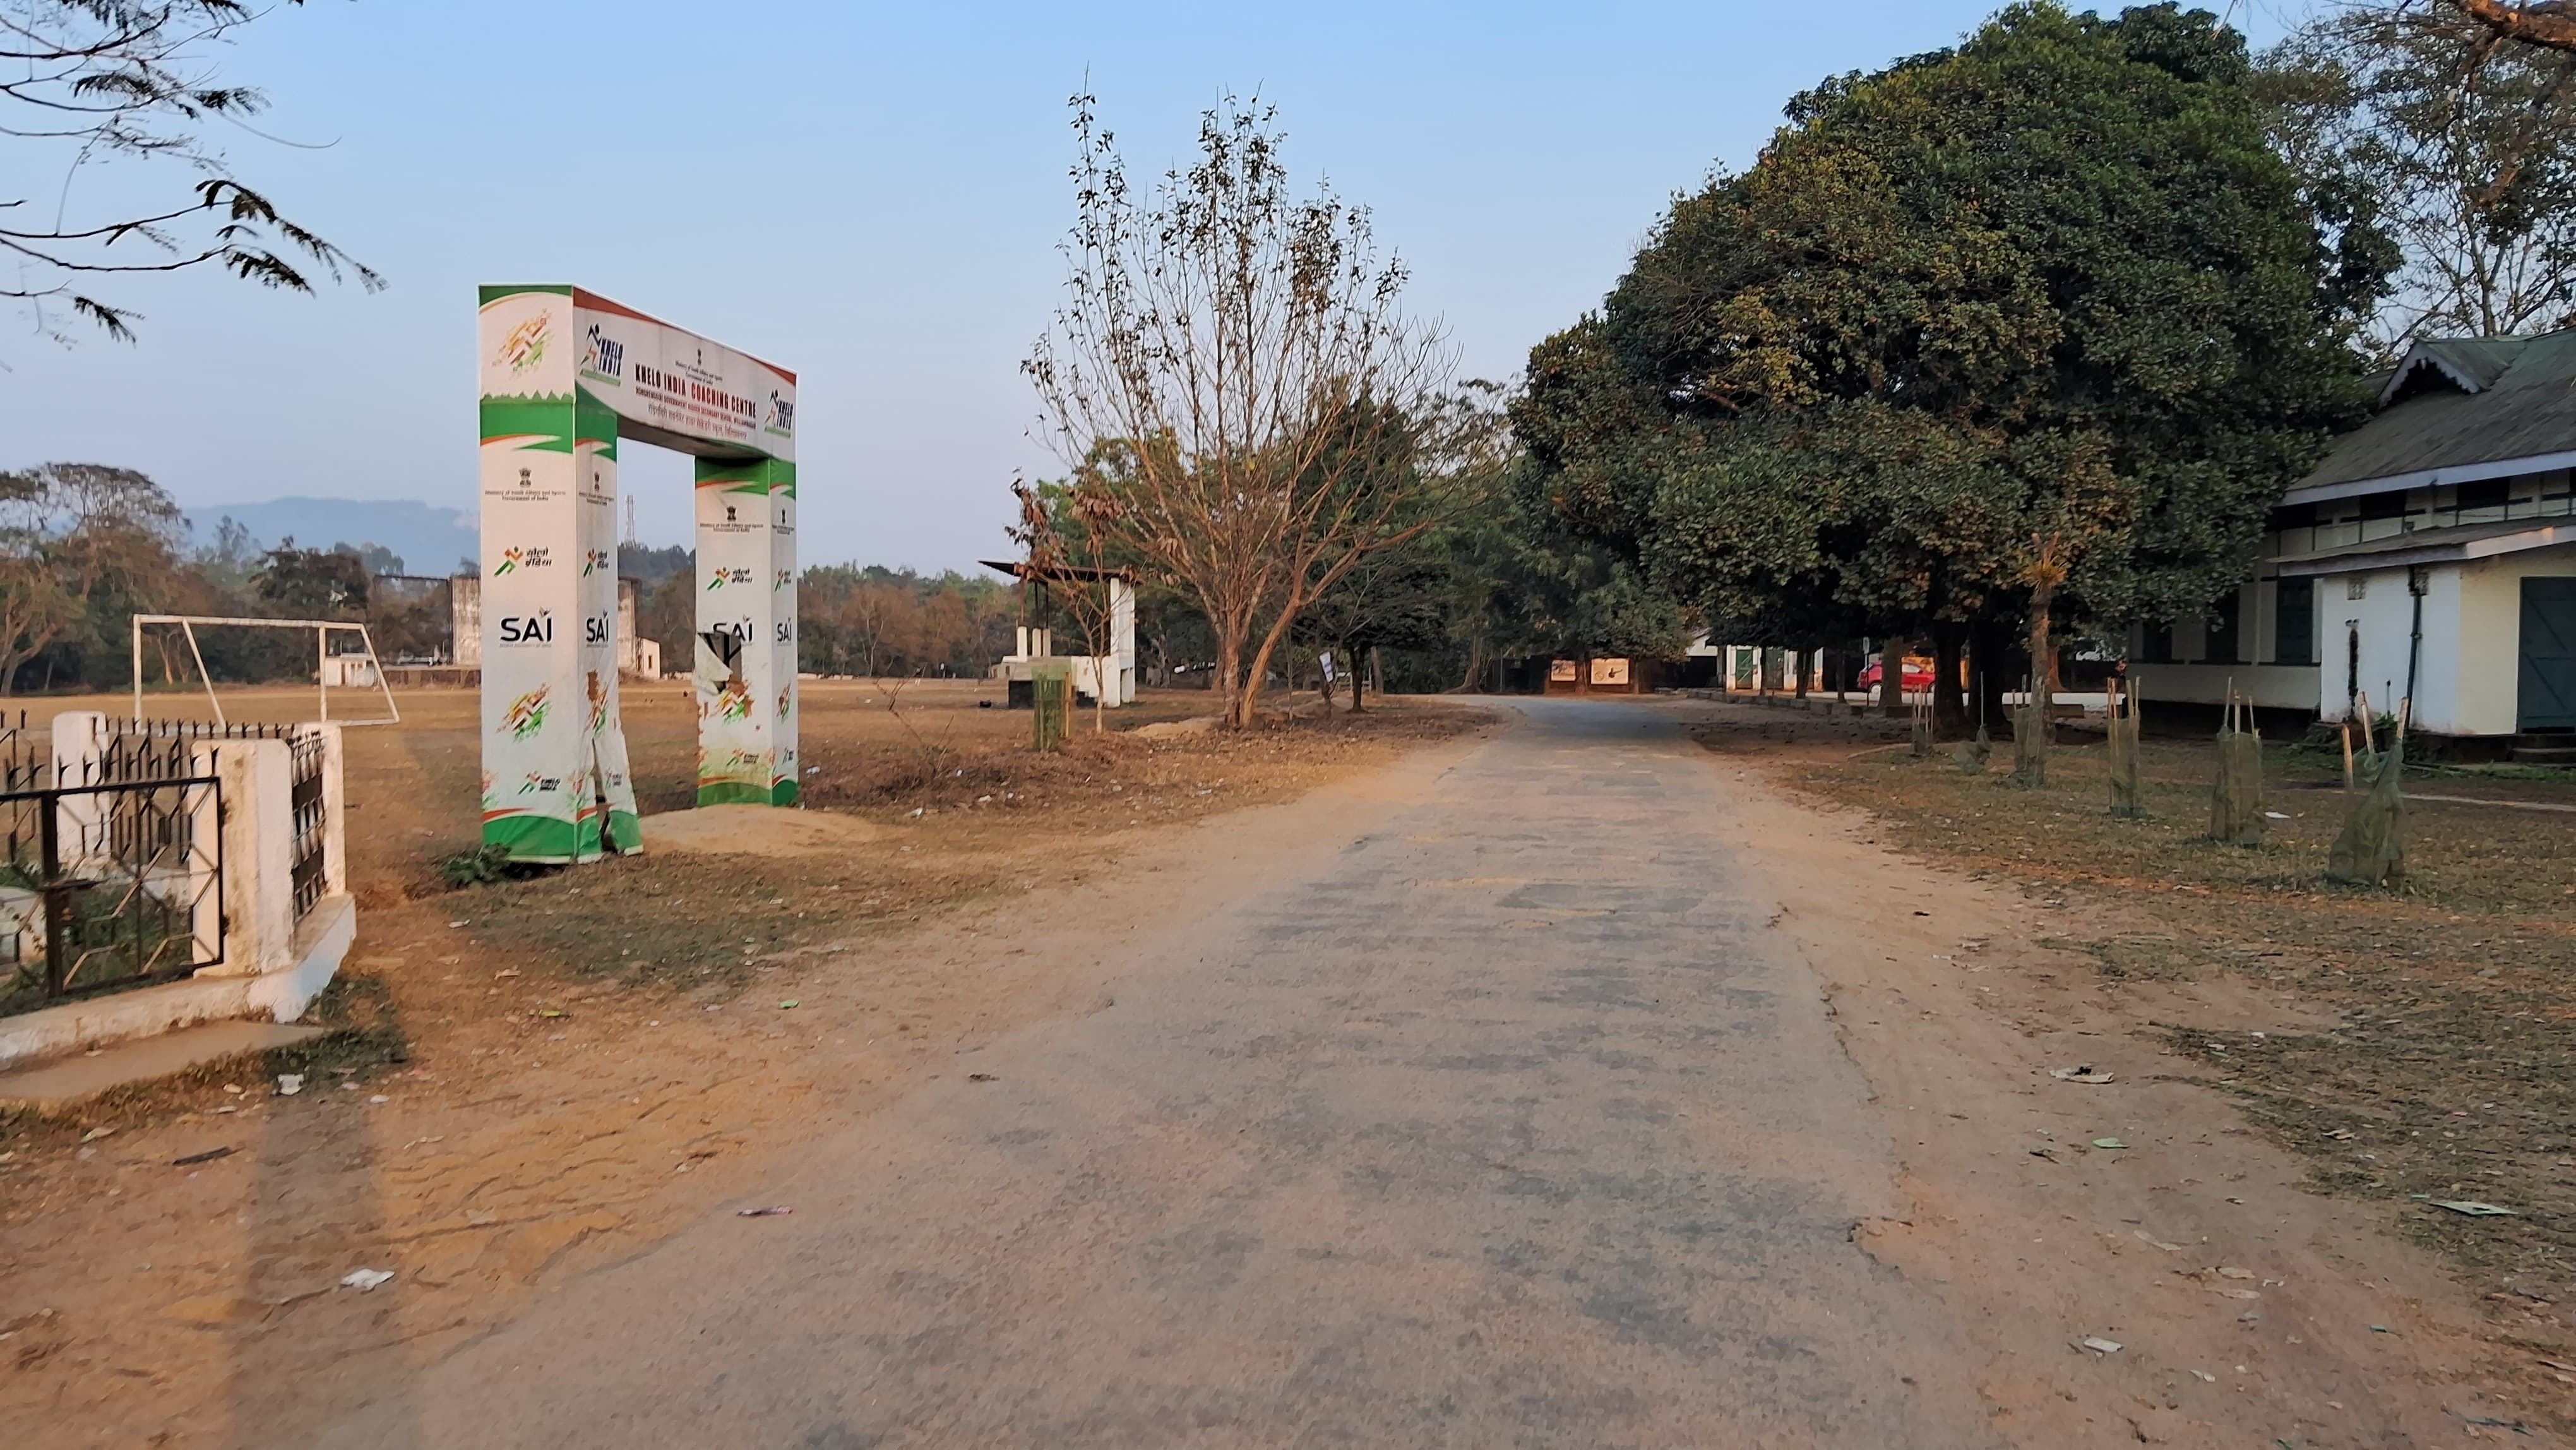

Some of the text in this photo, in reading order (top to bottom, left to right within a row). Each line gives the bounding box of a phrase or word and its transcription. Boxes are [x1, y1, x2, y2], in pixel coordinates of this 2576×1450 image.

[601, 339, 623, 360] KHELO
[599, 354, 621, 377] INDIA
[635, 363, 660, 389] KHELO
[664, 373, 686, 397] INDIA
[691, 382, 729, 410] COACHING
[732, 395, 756, 418] CENTRE
[500, 617, 552, 642] SAI
[586, 617, 609, 643] SAI
[777, 622, 792, 642] SAI
